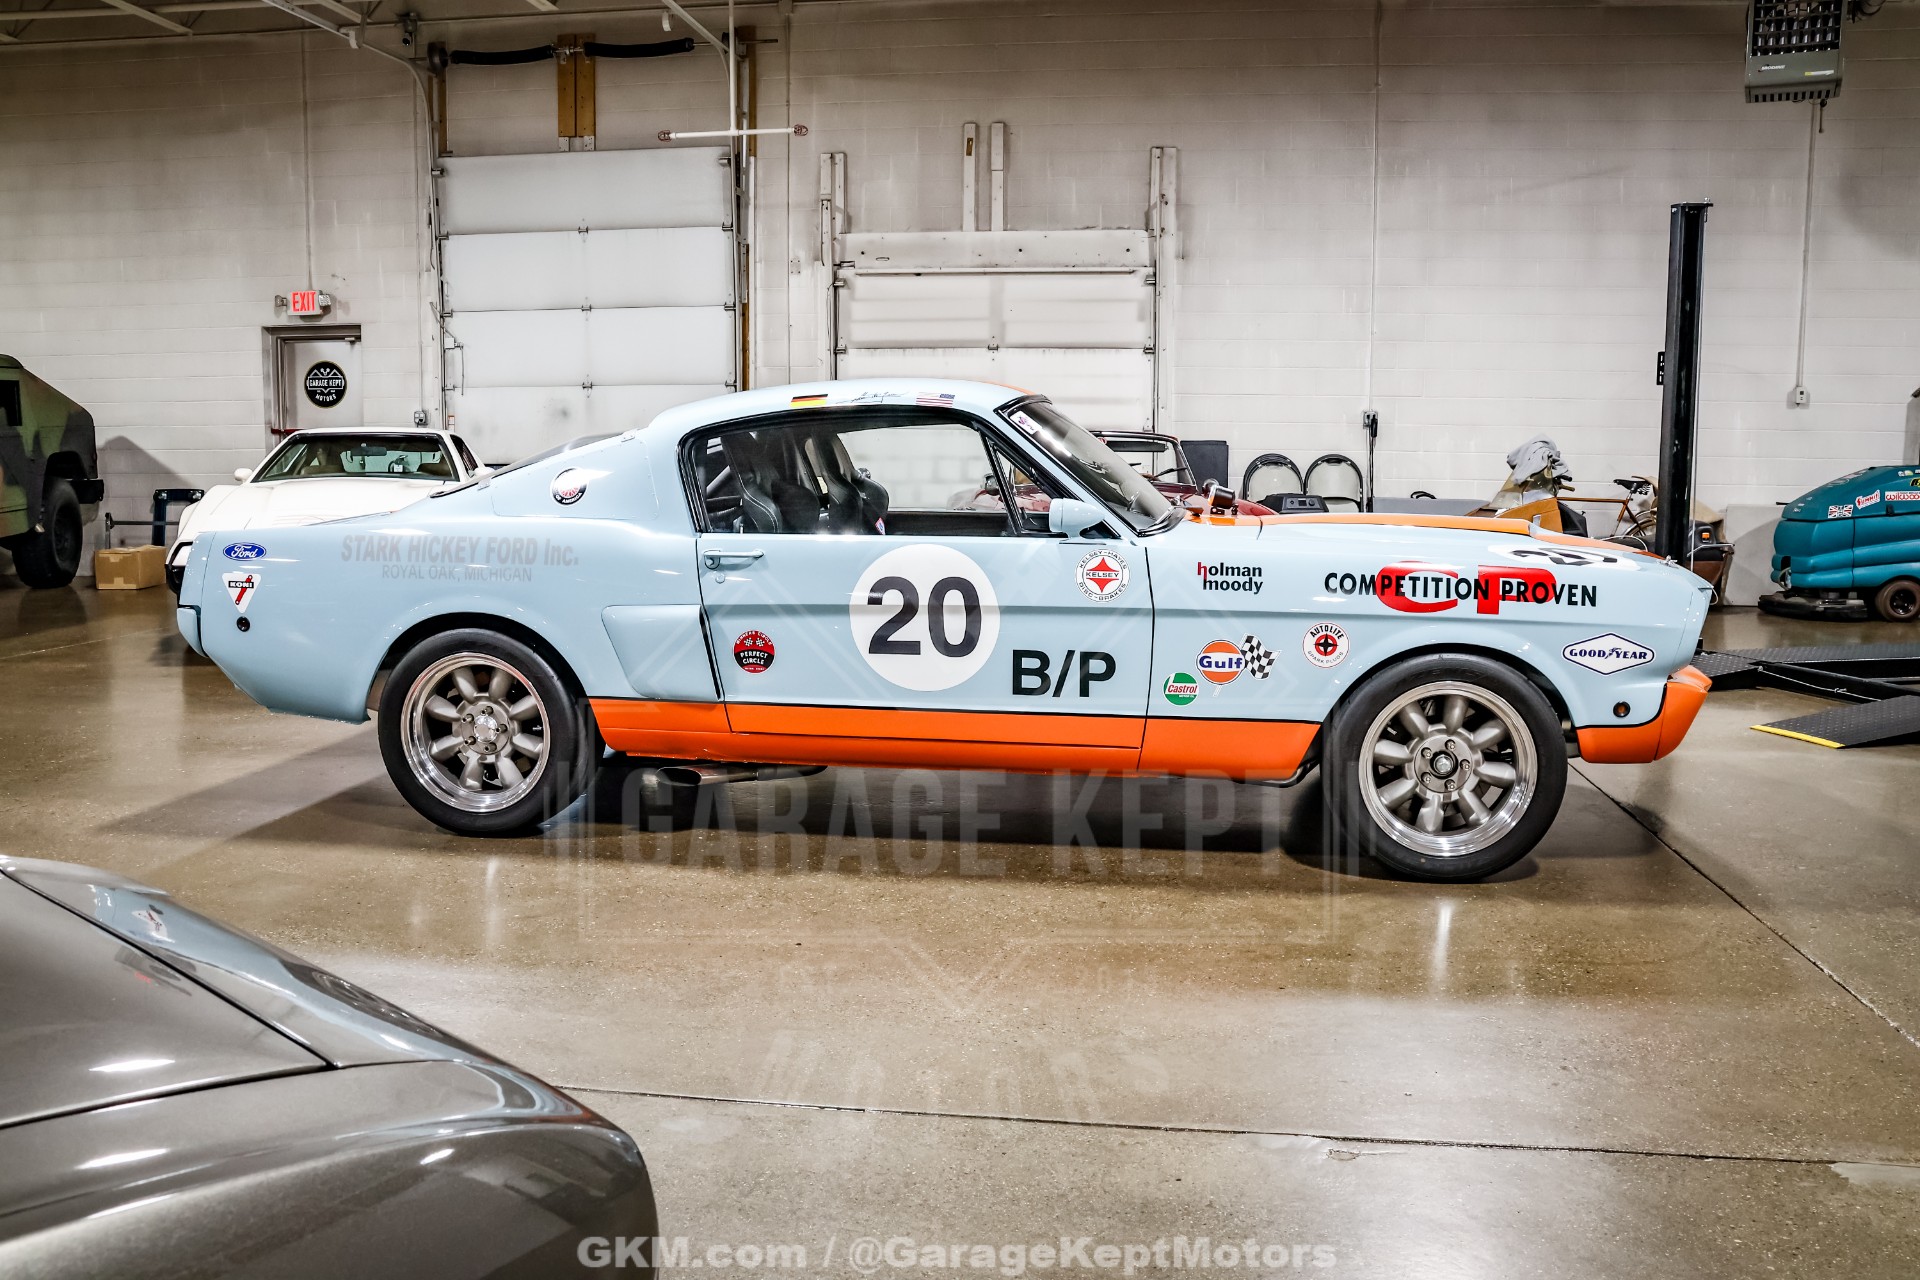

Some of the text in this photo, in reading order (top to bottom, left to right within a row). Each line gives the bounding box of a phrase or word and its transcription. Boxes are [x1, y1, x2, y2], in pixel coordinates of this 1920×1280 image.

[292, 291, 316, 312] EXIT
[231, 545, 258, 558] Ford
[341, 535, 579, 567] STARK HICKEY FORD Inc.
[382, 564, 532, 582] ROYAL OAK, MICHIGAN
[1197, 562, 1262, 579] holman
[1203, 577, 1263, 595] moody
[1324, 572, 1597, 607] COMPETITION PROVEN
[867, 576, 982, 657] 20
[1309, 625, 1344, 640] AUTOLITE
[1199, 655, 1243, 669] Gulf
[1012, 649, 1117, 698] B/P
[1167, 685, 1198, 694] Castrol
